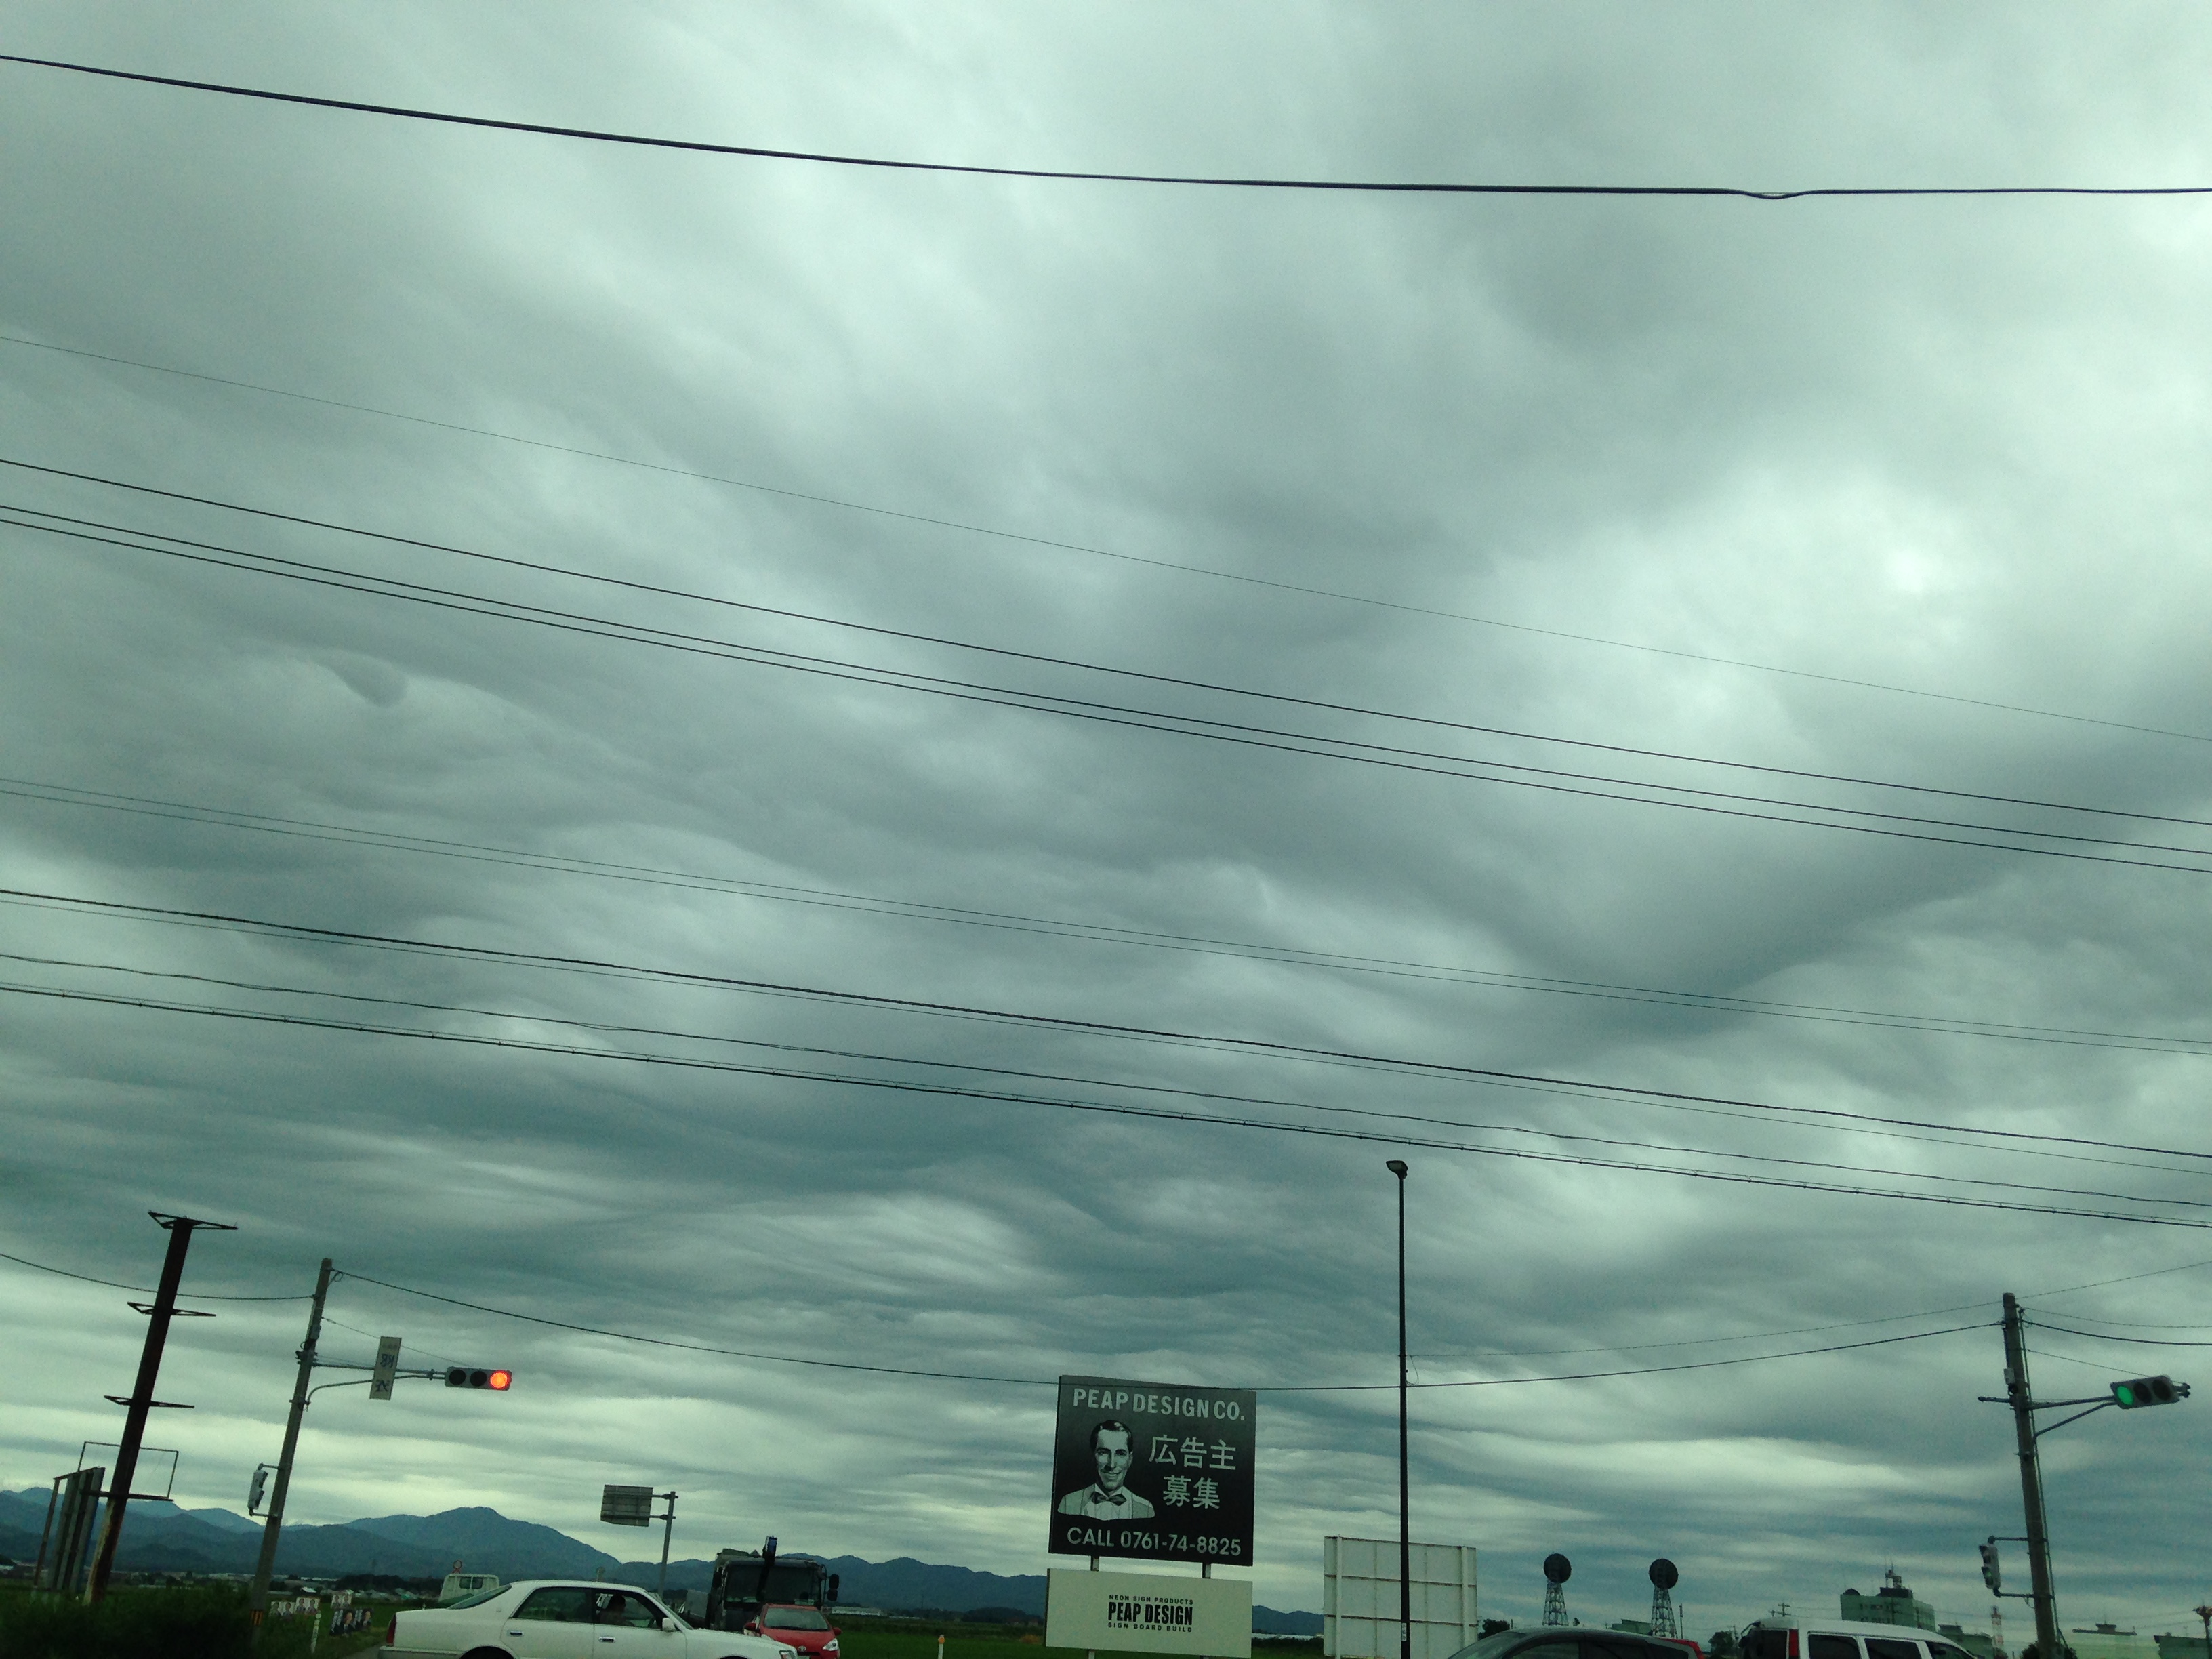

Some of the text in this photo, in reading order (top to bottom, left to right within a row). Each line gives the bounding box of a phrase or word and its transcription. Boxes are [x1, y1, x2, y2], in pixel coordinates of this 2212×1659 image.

[1073, 1388, 1245, 1420] PEAP DESIGN CO.
[1149, 1435, 1236, 1471] 広告主
[1163, 1475, 1220, 1509] 募集
[1067, 1527, 1241, 1556] CALL 0761-74-8825
[1108, 1602, 1193, 1625] PEAP DESIGN
